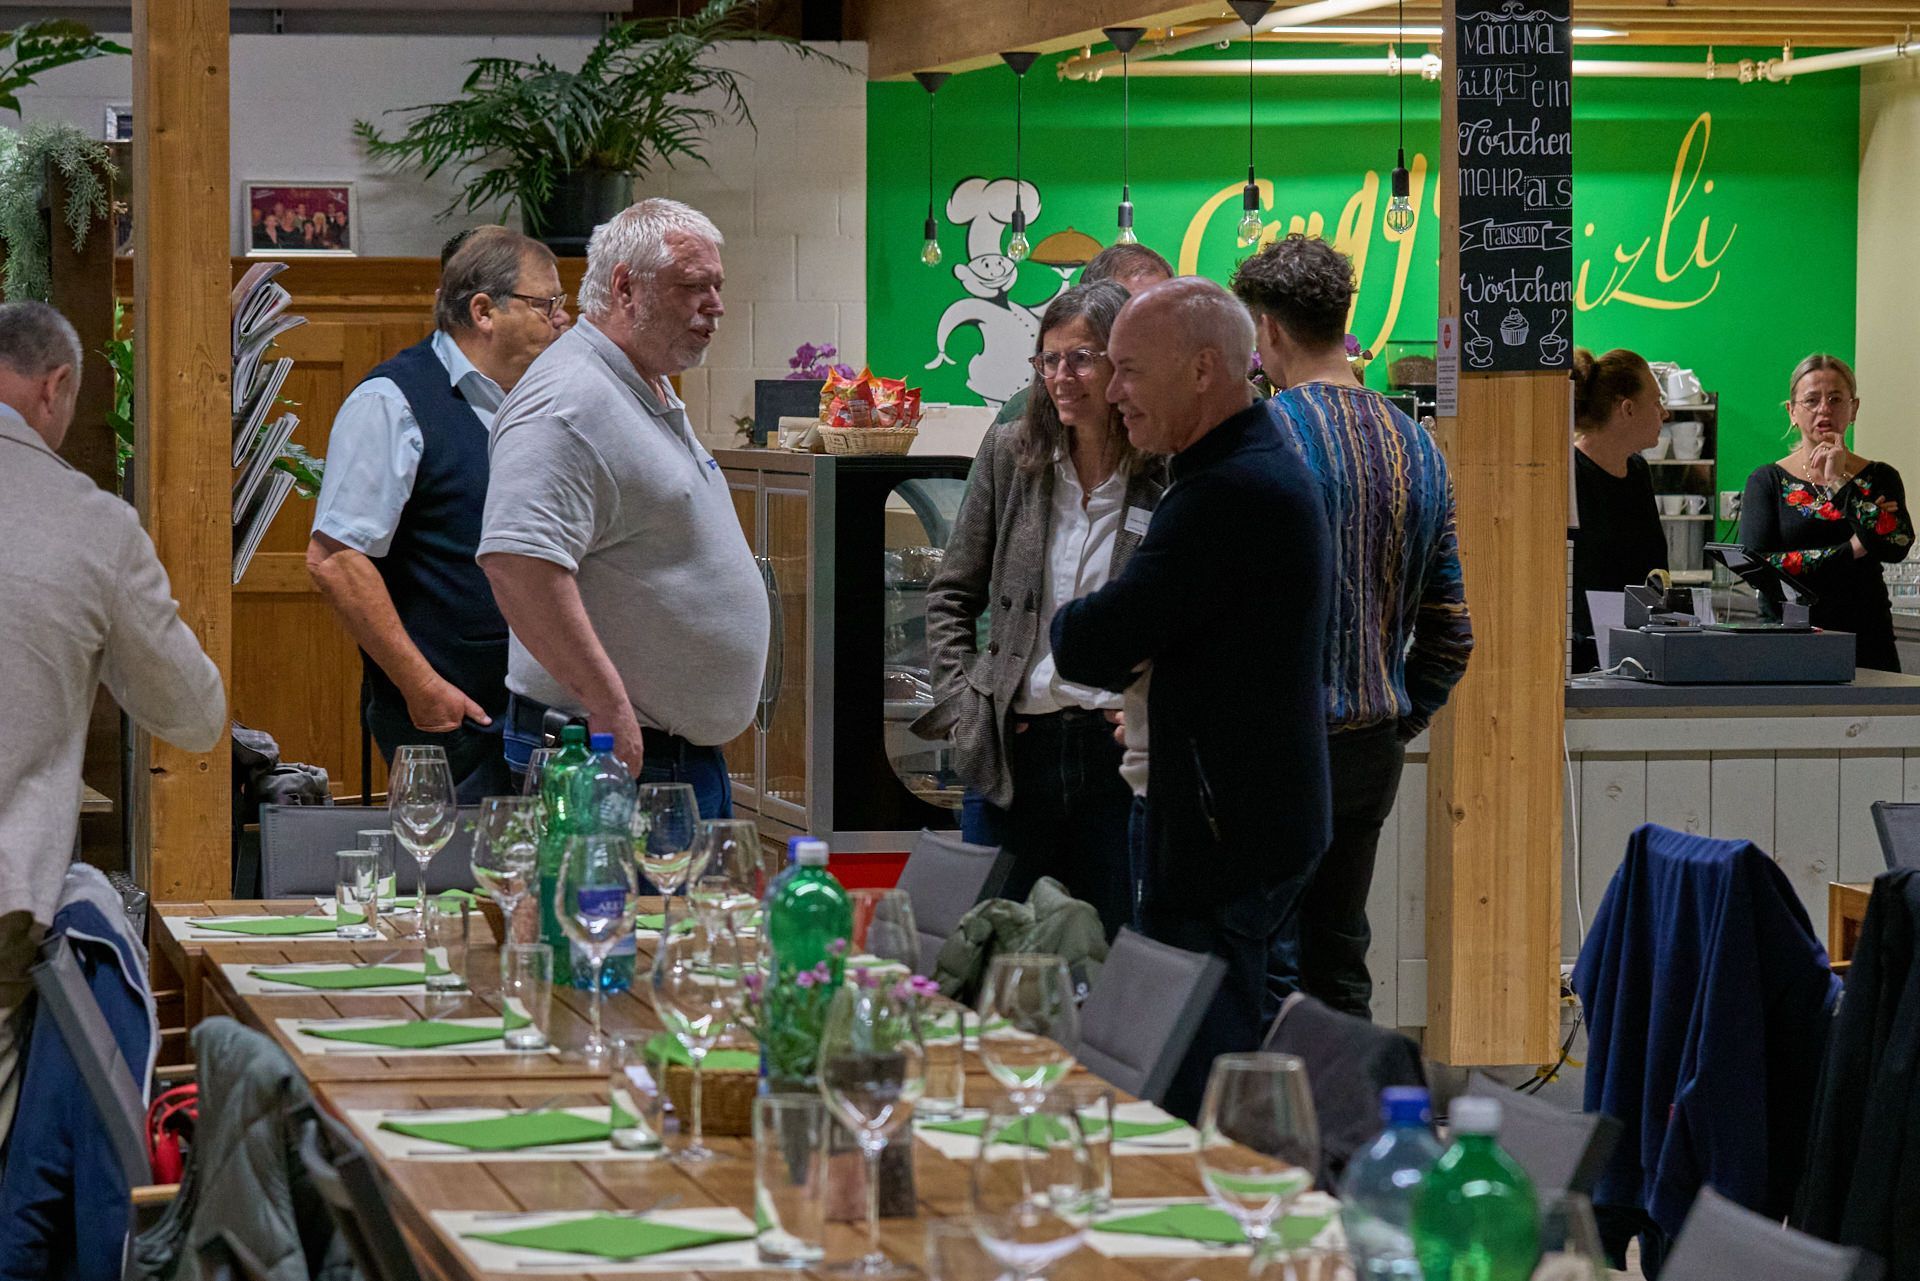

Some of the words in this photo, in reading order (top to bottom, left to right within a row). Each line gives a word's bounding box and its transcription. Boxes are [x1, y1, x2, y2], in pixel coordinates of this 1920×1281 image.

[1457, 65, 1538, 107] hilft
[1458, 117, 1572, 156] Törtchen
[1572, 111, 1738, 310] izli
[1459, 265, 1573, 303] Wörtchen
